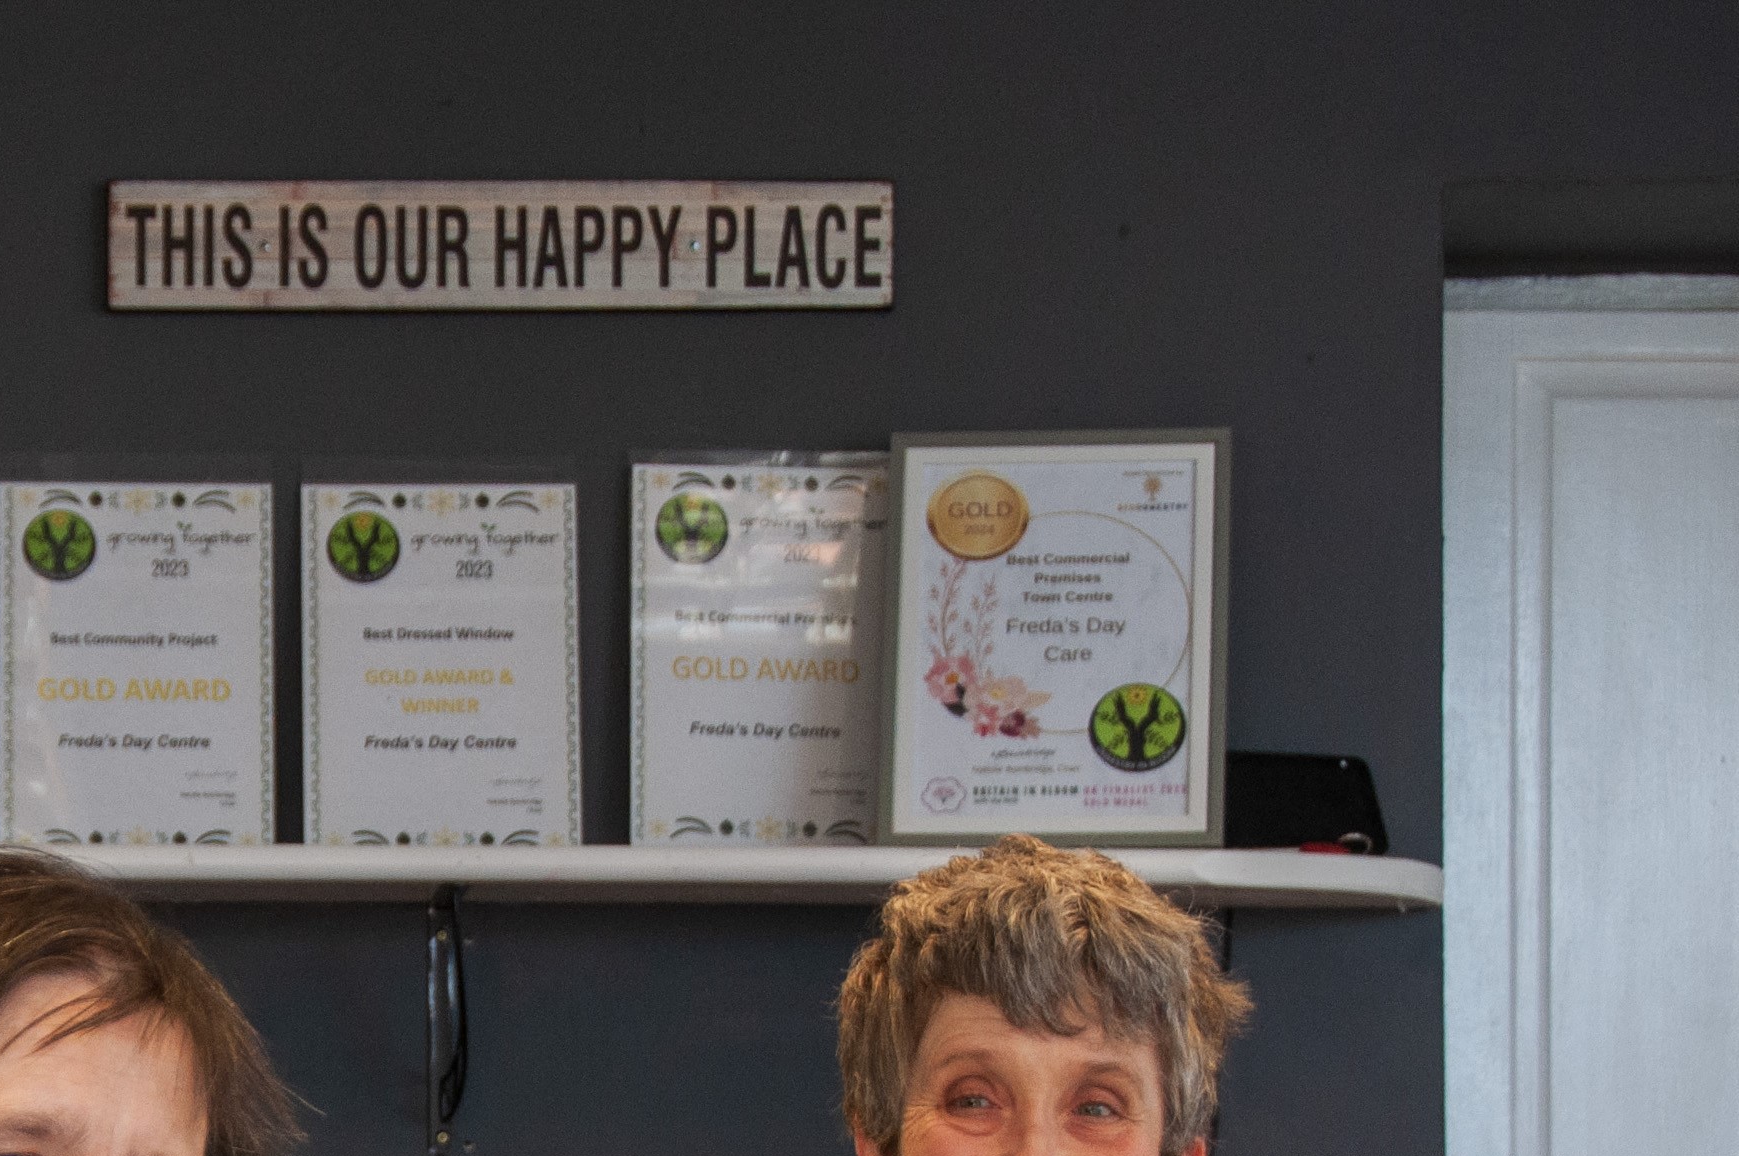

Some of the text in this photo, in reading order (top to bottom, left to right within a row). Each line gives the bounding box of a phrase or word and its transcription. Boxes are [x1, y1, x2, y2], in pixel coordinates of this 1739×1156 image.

[126, 204, 882, 288] THIS IS OUR HAPPY PLACE
[949, 502, 1013, 518] GOLD
[106, 531, 252, 555] growing together
[410, 531, 556, 555] growing together
[1007, 553, 1130, 565] Best Commercial
[1034, 572, 1101, 585] Premises
[1023, 590, 1113, 603] Town Centre
[364, 628, 513, 640] Best Dressed Window
[1006, 618, 1126, 637] Freda's Day
[50, 633, 218, 646] Best Community Project
[1044, 646, 1092, 662] Care
[365, 670, 416, 684] GOLD
[422, 670, 493, 684] AWARD
[672, 656, 859, 683] GOLD AWARD
[37, 678, 231, 701] GOLD AWARD
[401, 699, 479, 713] WINNER
[689, 721, 841, 739] Freda's Day Centre
[58, 735, 210, 750] Freda's Day Centre
[364, 735, 517, 750] Freda's Day Centre
